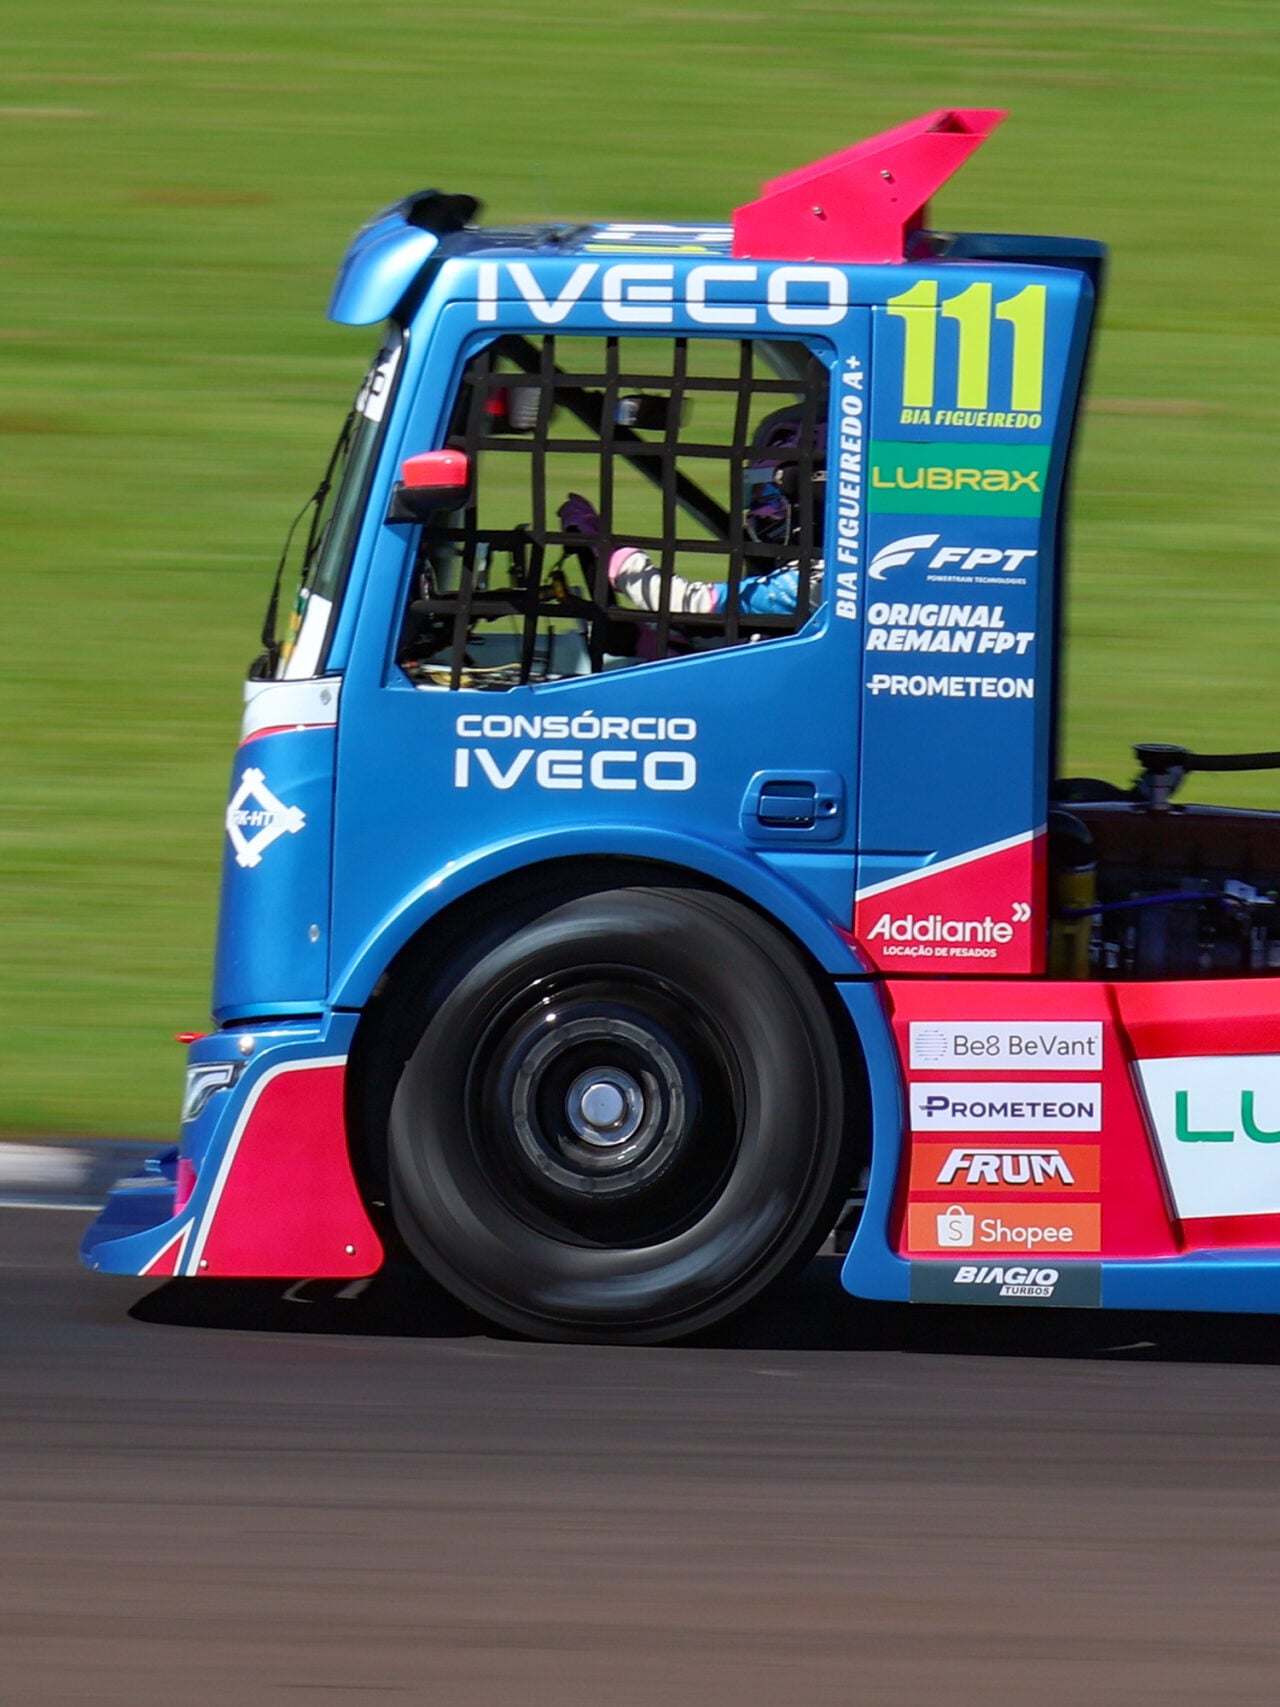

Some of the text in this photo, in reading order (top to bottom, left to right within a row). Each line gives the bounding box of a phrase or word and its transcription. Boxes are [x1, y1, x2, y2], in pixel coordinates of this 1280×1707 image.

[476, 262, 849, 326] IVECO
[886, 279, 1046, 412] 111
[900, 408, 1042, 430] BIA FIGUEIREDO
[835, 355, 864, 620] BIA FIGUEIREDO A+
[927, 547, 1038, 572] FPT
[926, 575, 1027, 585] POWERTRAIN TECHNOLOGIES
[867, 602, 1006, 628] ORIGINAL
[866, 628, 1035, 655] REMAN FPT
[866, 674, 1035, 699] PROMETEON
[456, 710, 697, 740] CONSÓRCIO
[454, 748, 697, 790] IVECO
[867, 914, 1014, 943] Addiante
[883, 945, 997, 958] LOCAÇÃO DE PESADOS
[953, 1035, 1000, 1056] Be8
[919, 1096, 1094, 1118] PROMETEON
[936, 1148, 1075, 1184] FRUM
[980, 1219, 1073, 1249] Shopee
[953, 1266, 1060, 1285] BIAGIO
[1004, 1286, 1050, 1296] TURBOS
